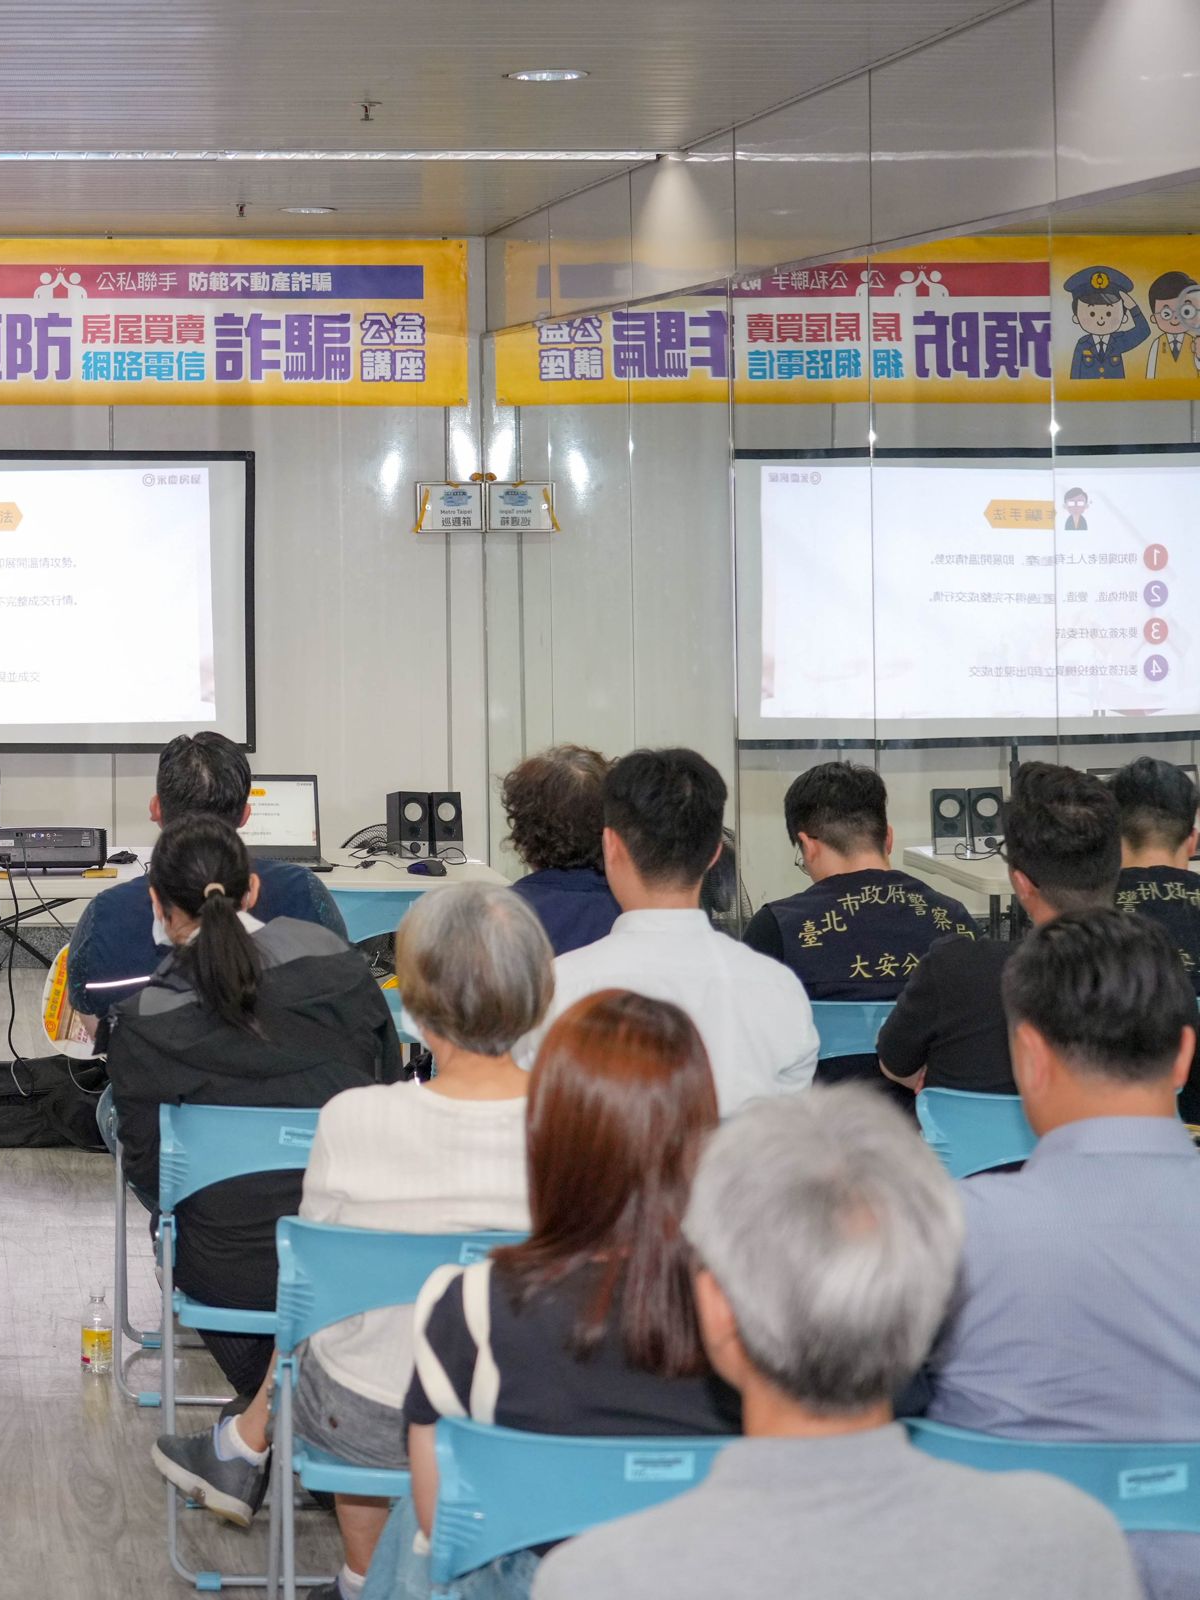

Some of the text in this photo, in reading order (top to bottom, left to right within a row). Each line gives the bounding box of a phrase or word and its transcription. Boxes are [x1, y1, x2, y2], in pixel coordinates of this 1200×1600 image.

[97, 271, 332, 292] 公私聯手 防範不動產詐騙
[81, 314, 205, 344] 房屋買賣
[360, 313, 425, 346] 公益
[214, 313, 351, 381] 詐騙
[81, 351, 205, 381] 網路電信
[360, 349, 425, 382] 講座
